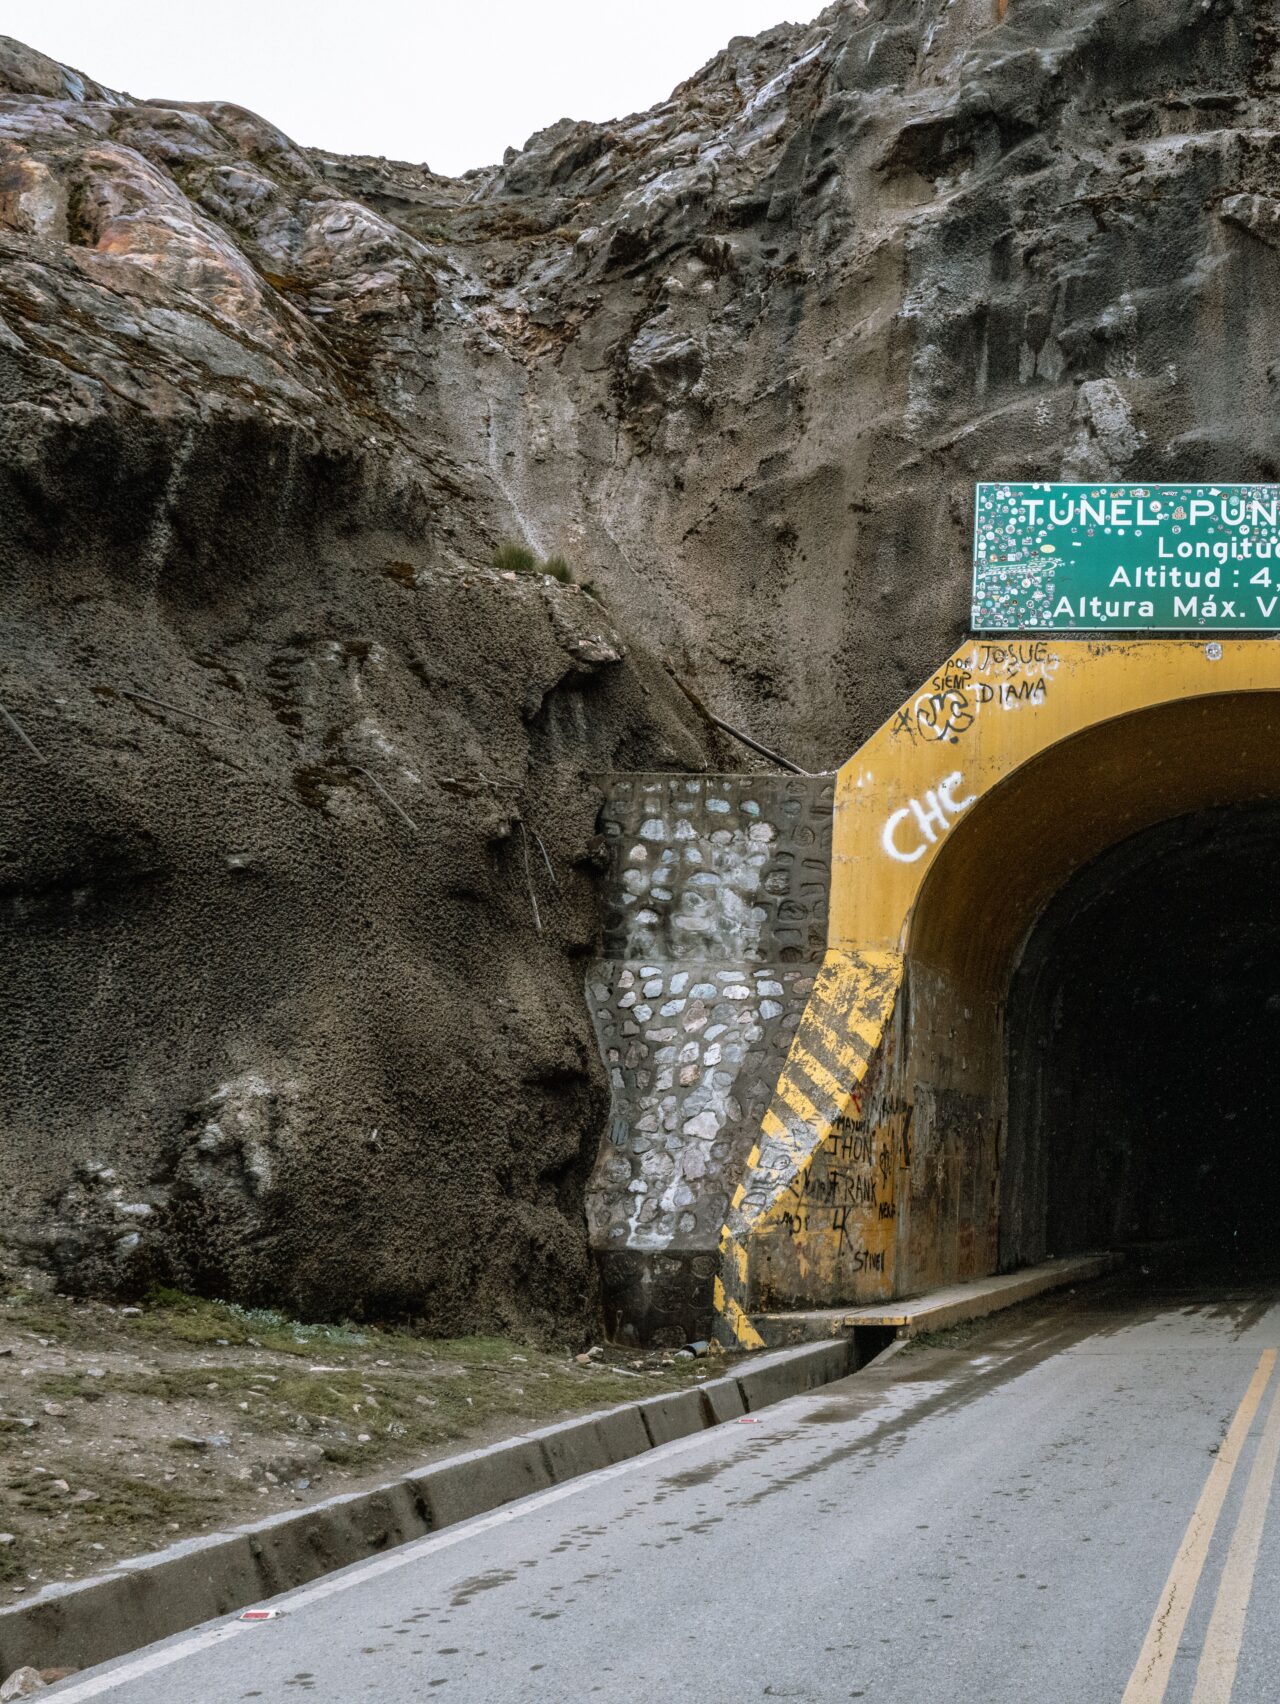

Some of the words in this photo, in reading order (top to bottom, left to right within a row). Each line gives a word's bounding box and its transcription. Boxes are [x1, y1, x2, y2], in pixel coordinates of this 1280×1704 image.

[1021, 493, 1160, 526] TÚNEL
[1109, 565, 1220, 588] Altitud
[1052, 595, 1154, 618] Altura
[1173, 594, 1245, 618] Máx.
[976, 677, 1048, 705] DIANA
